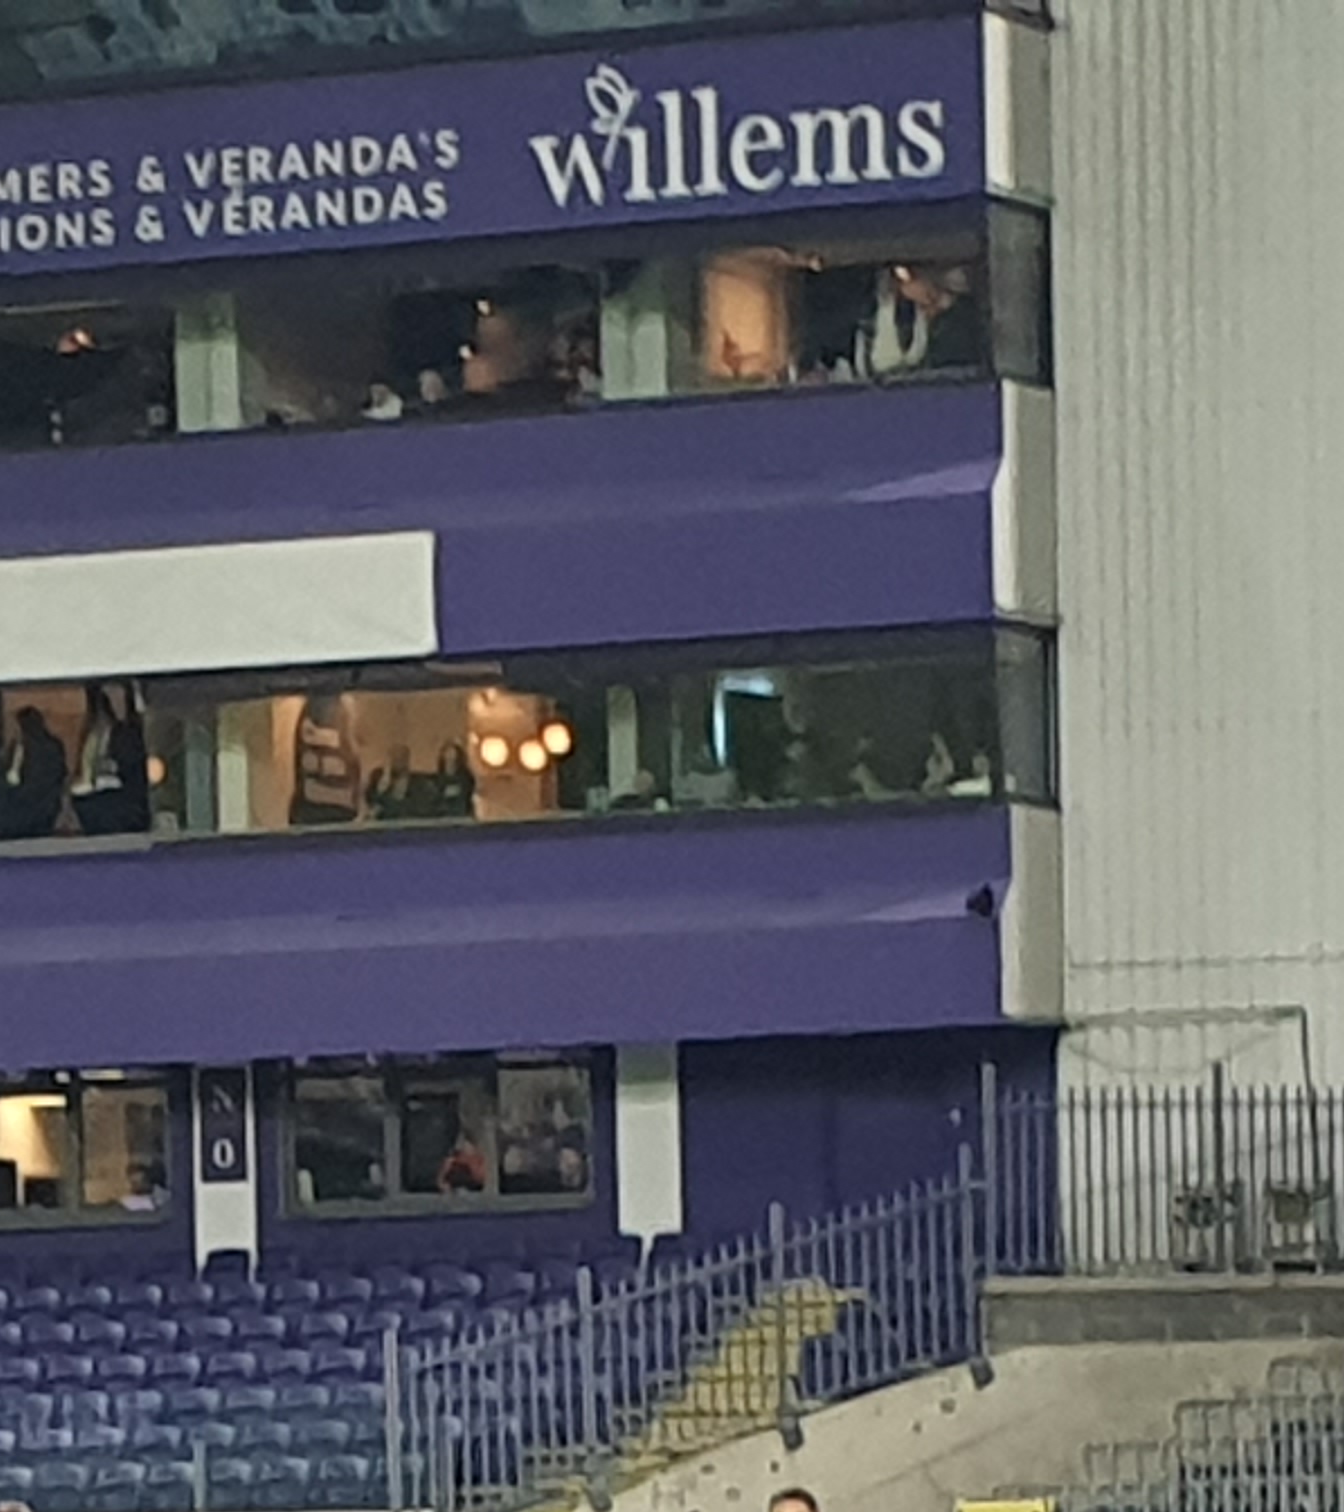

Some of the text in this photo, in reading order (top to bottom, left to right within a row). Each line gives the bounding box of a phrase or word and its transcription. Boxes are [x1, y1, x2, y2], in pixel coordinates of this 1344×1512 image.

[136, 155, 165, 194] &
[183, 128, 460, 190] VERANDA'S
[529, 62, 946, 208] willems
[134, 205, 164, 242] &
